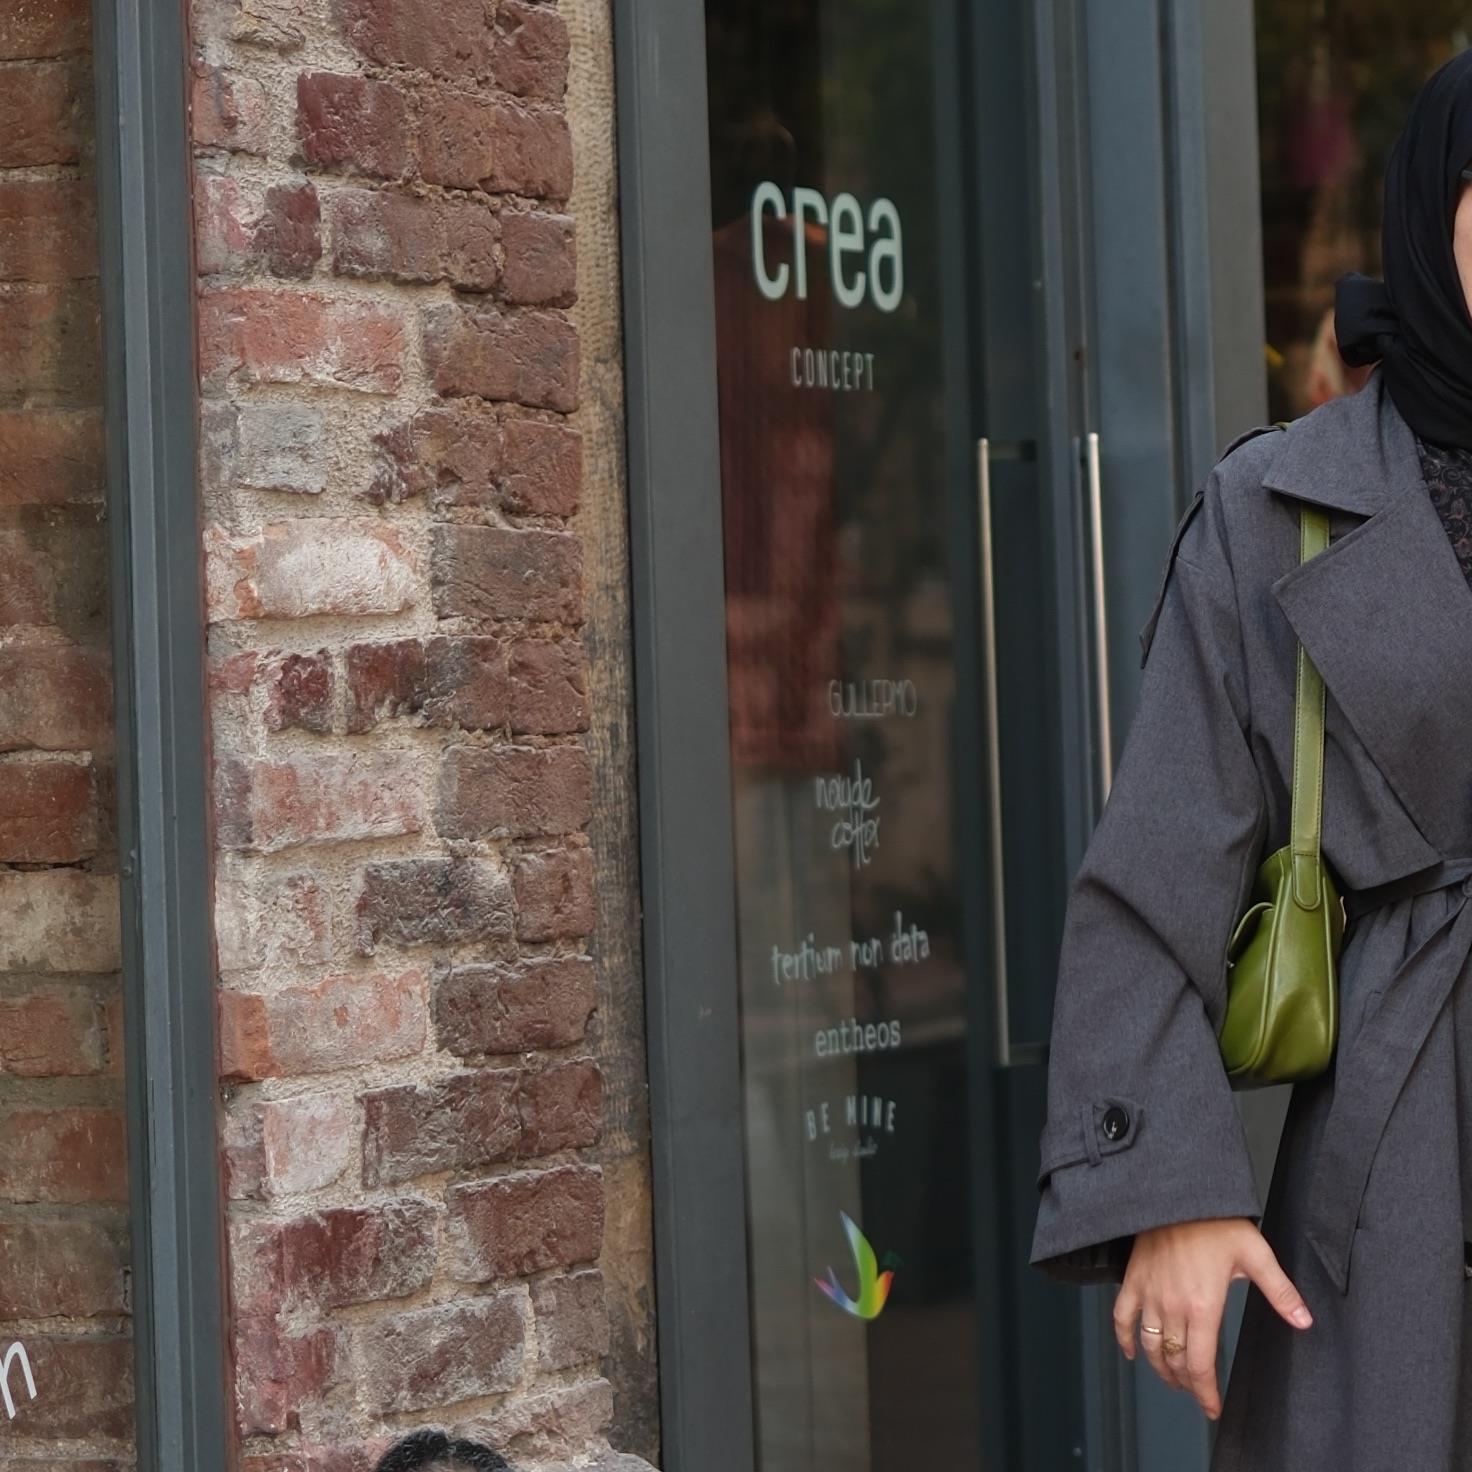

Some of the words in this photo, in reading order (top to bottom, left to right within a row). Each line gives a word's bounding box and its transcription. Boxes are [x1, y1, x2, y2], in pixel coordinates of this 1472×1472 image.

[752, 181, 904, 313] crea
[790, 346, 875, 391] CONCEPT
[815, 1017, 901, 1057] entheos
[806, 1102, 831, 1141] BE
[846, 1095, 897, 1133] MINE
